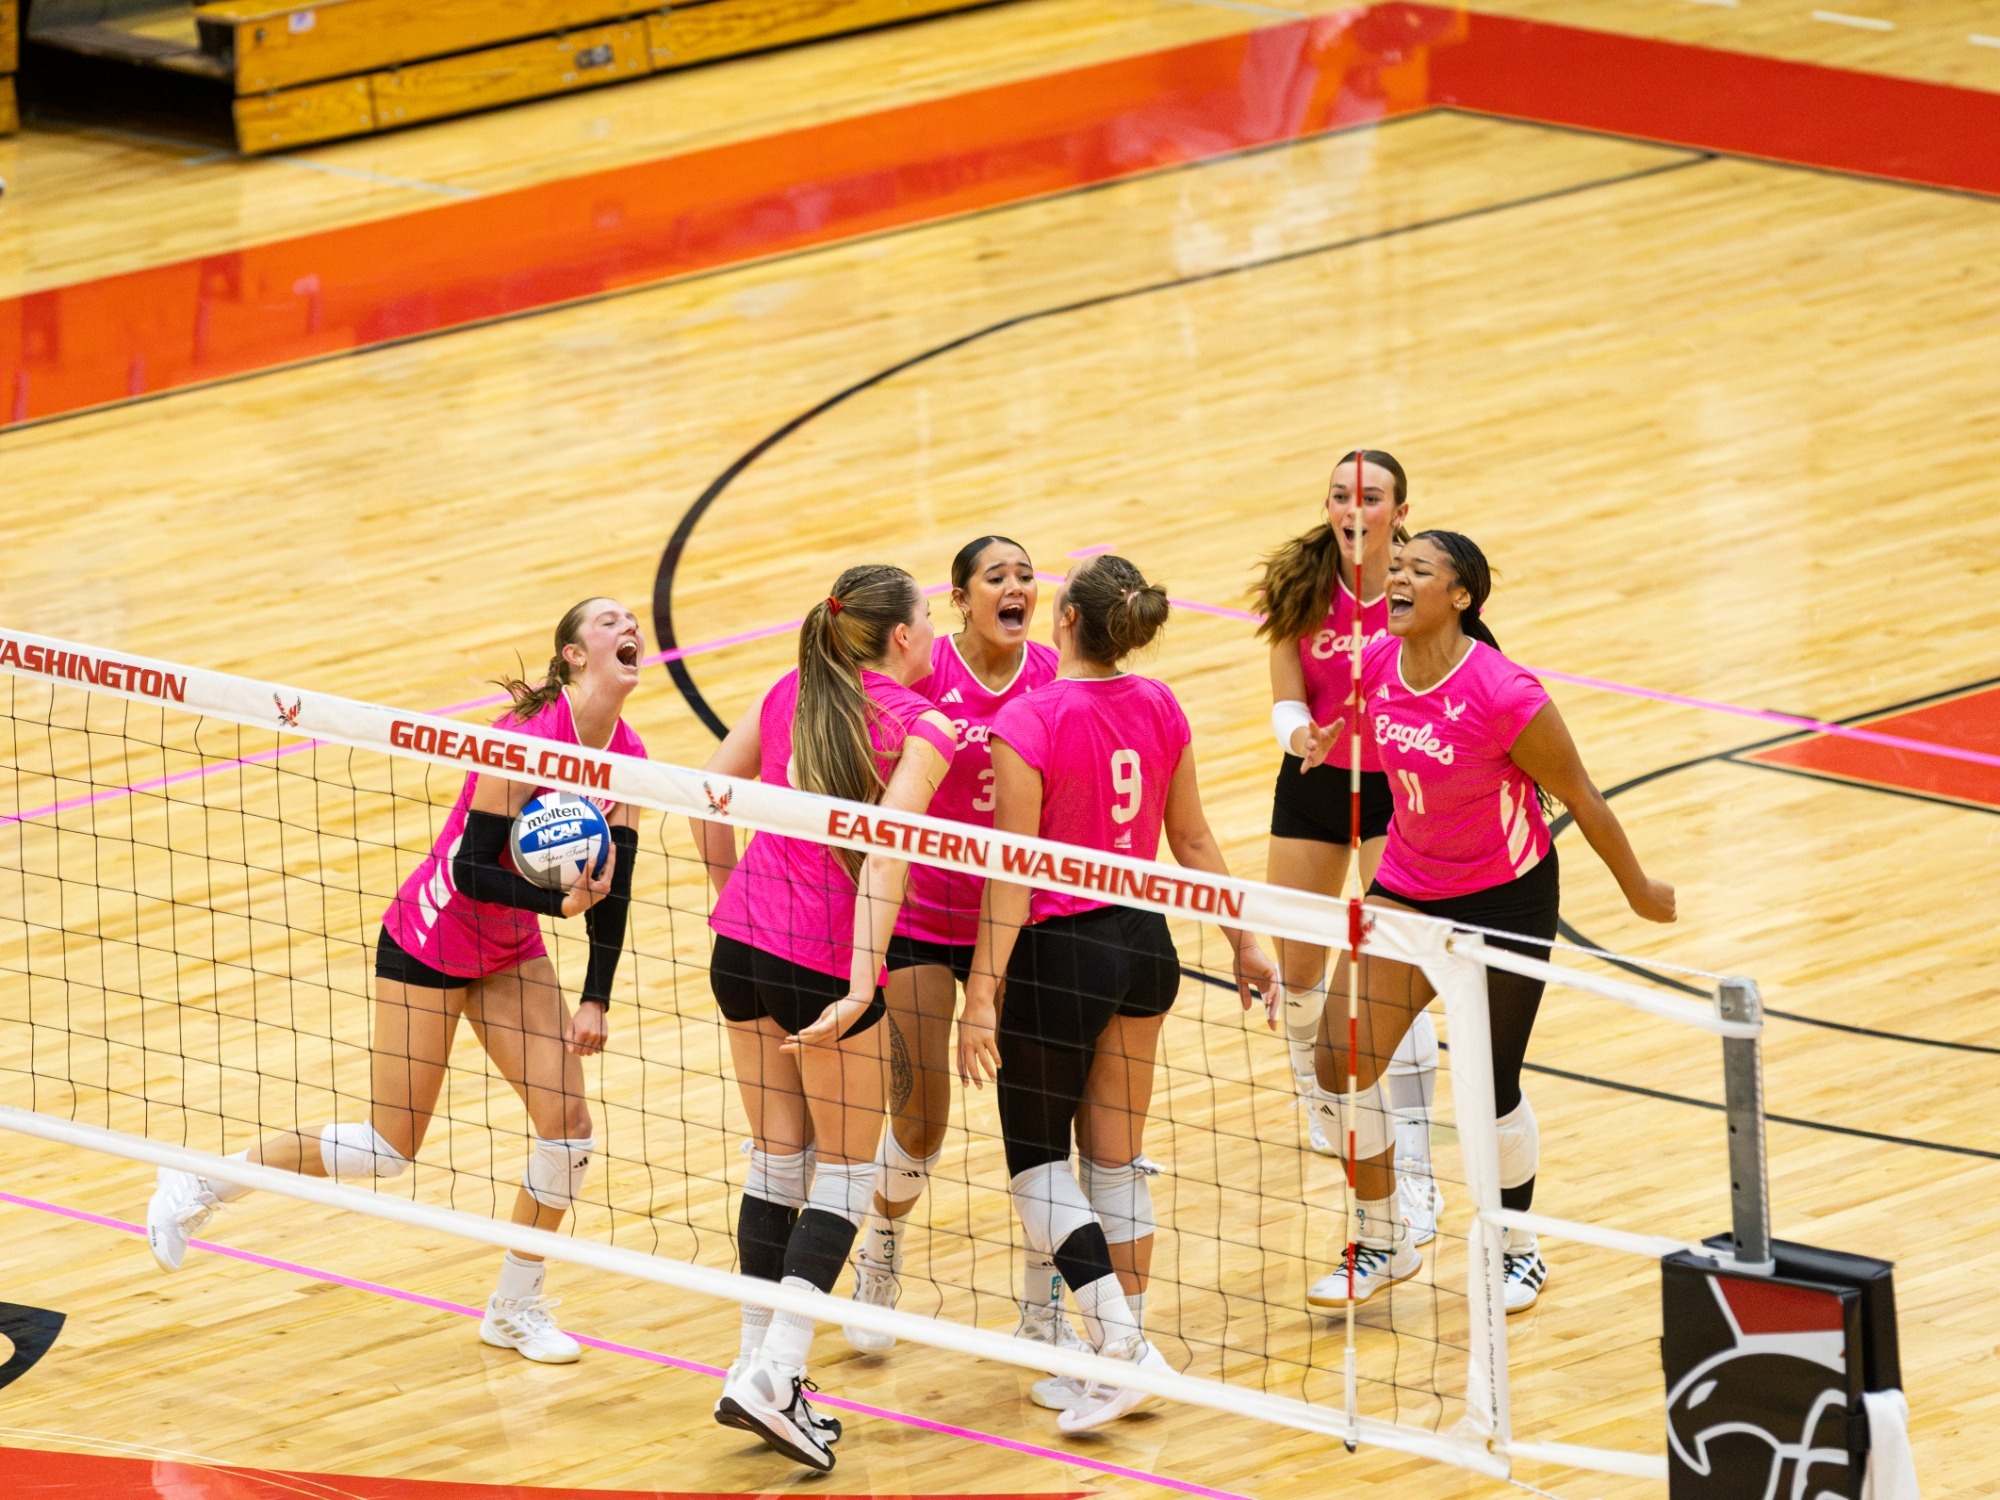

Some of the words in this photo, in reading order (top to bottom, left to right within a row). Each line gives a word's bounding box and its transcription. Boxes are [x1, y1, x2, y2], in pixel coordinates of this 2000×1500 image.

[0, 638, 188, 703] ASHINGTON
[390, 720, 613, 790] GOEAGS.COM
[1375, 714, 1454, 766] Eagles
[1111, 748, 1143, 825] 9
[1397, 769, 1426, 815] 11
[527, 806, 582, 831] molten
[536, 820, 583, 847] NCAA
[827, 809, 990, 867] EASTERN
[1002, 844, 1246, 919] WASHINGTON
